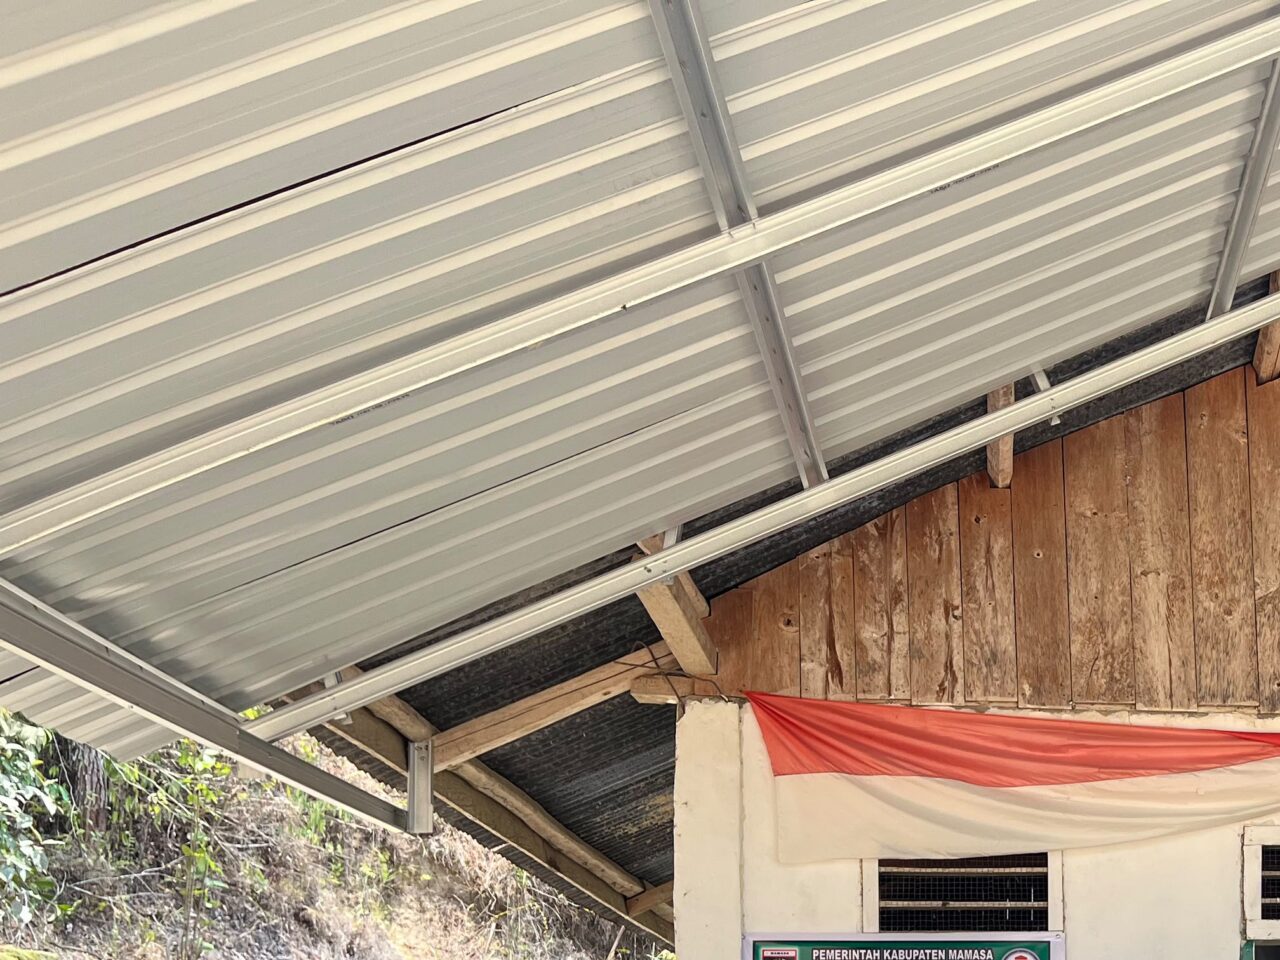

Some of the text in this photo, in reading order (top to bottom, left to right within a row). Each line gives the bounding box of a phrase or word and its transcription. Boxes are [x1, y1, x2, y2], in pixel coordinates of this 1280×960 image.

[812, 949, 994, 960] PEMERINTAH KABUPATEN MAMASA
